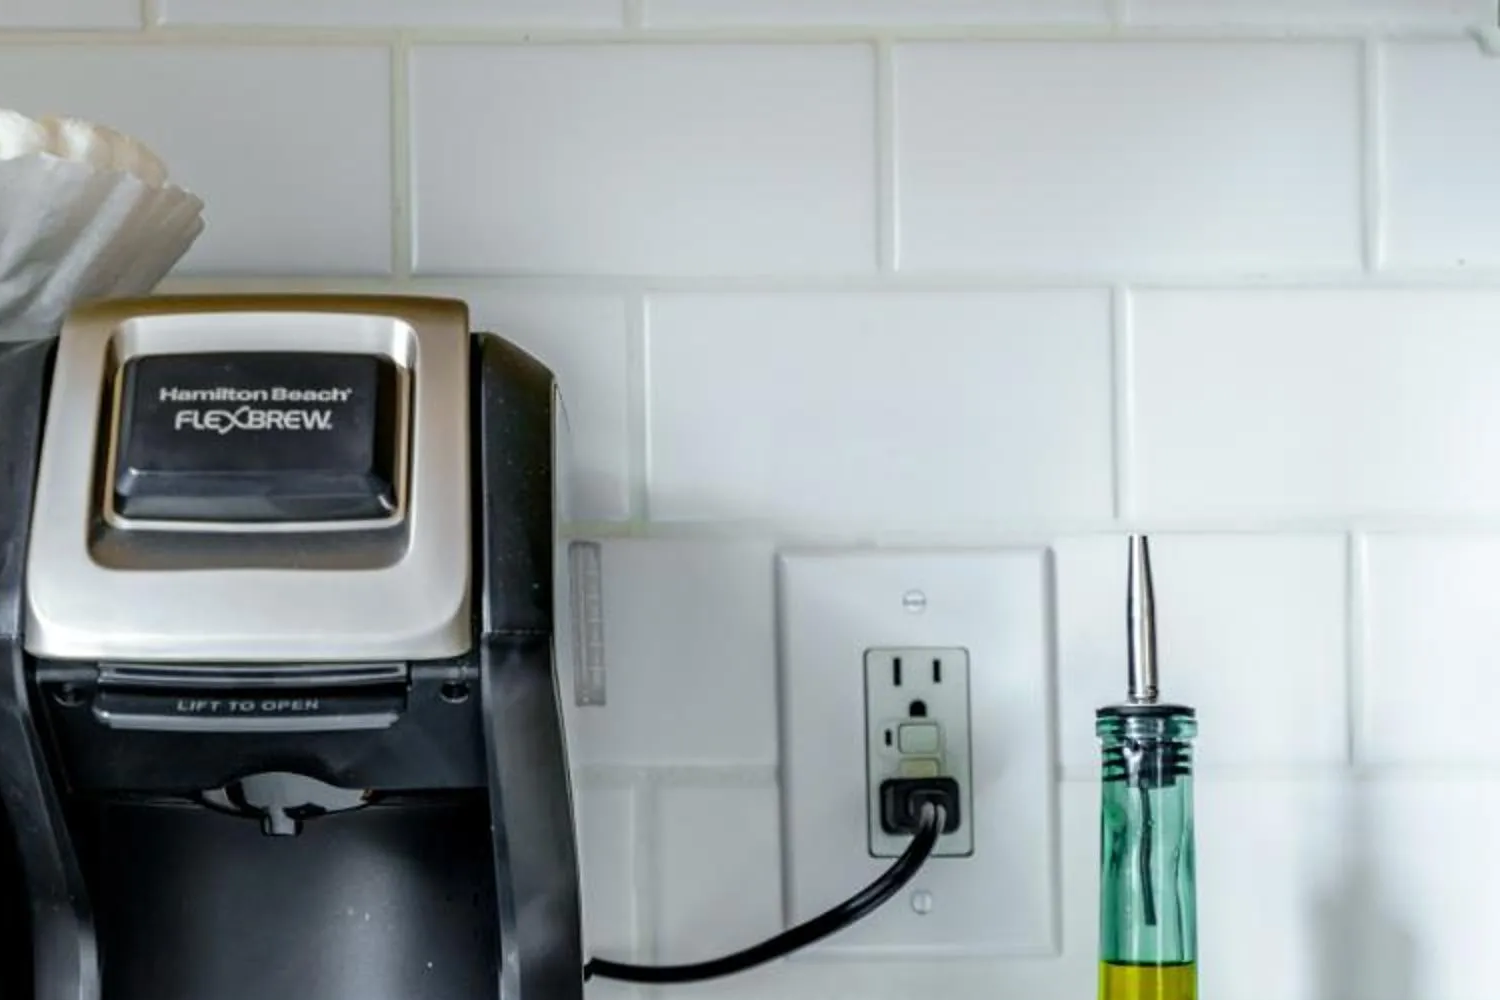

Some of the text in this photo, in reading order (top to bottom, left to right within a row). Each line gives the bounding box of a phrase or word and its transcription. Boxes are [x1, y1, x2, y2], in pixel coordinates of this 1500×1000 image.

[160, 387, 268, 401] Hamilton
[175, 405, 333, 435] FLEXBREW
[176, 699, 320, 712] LIFT TO OPEN
